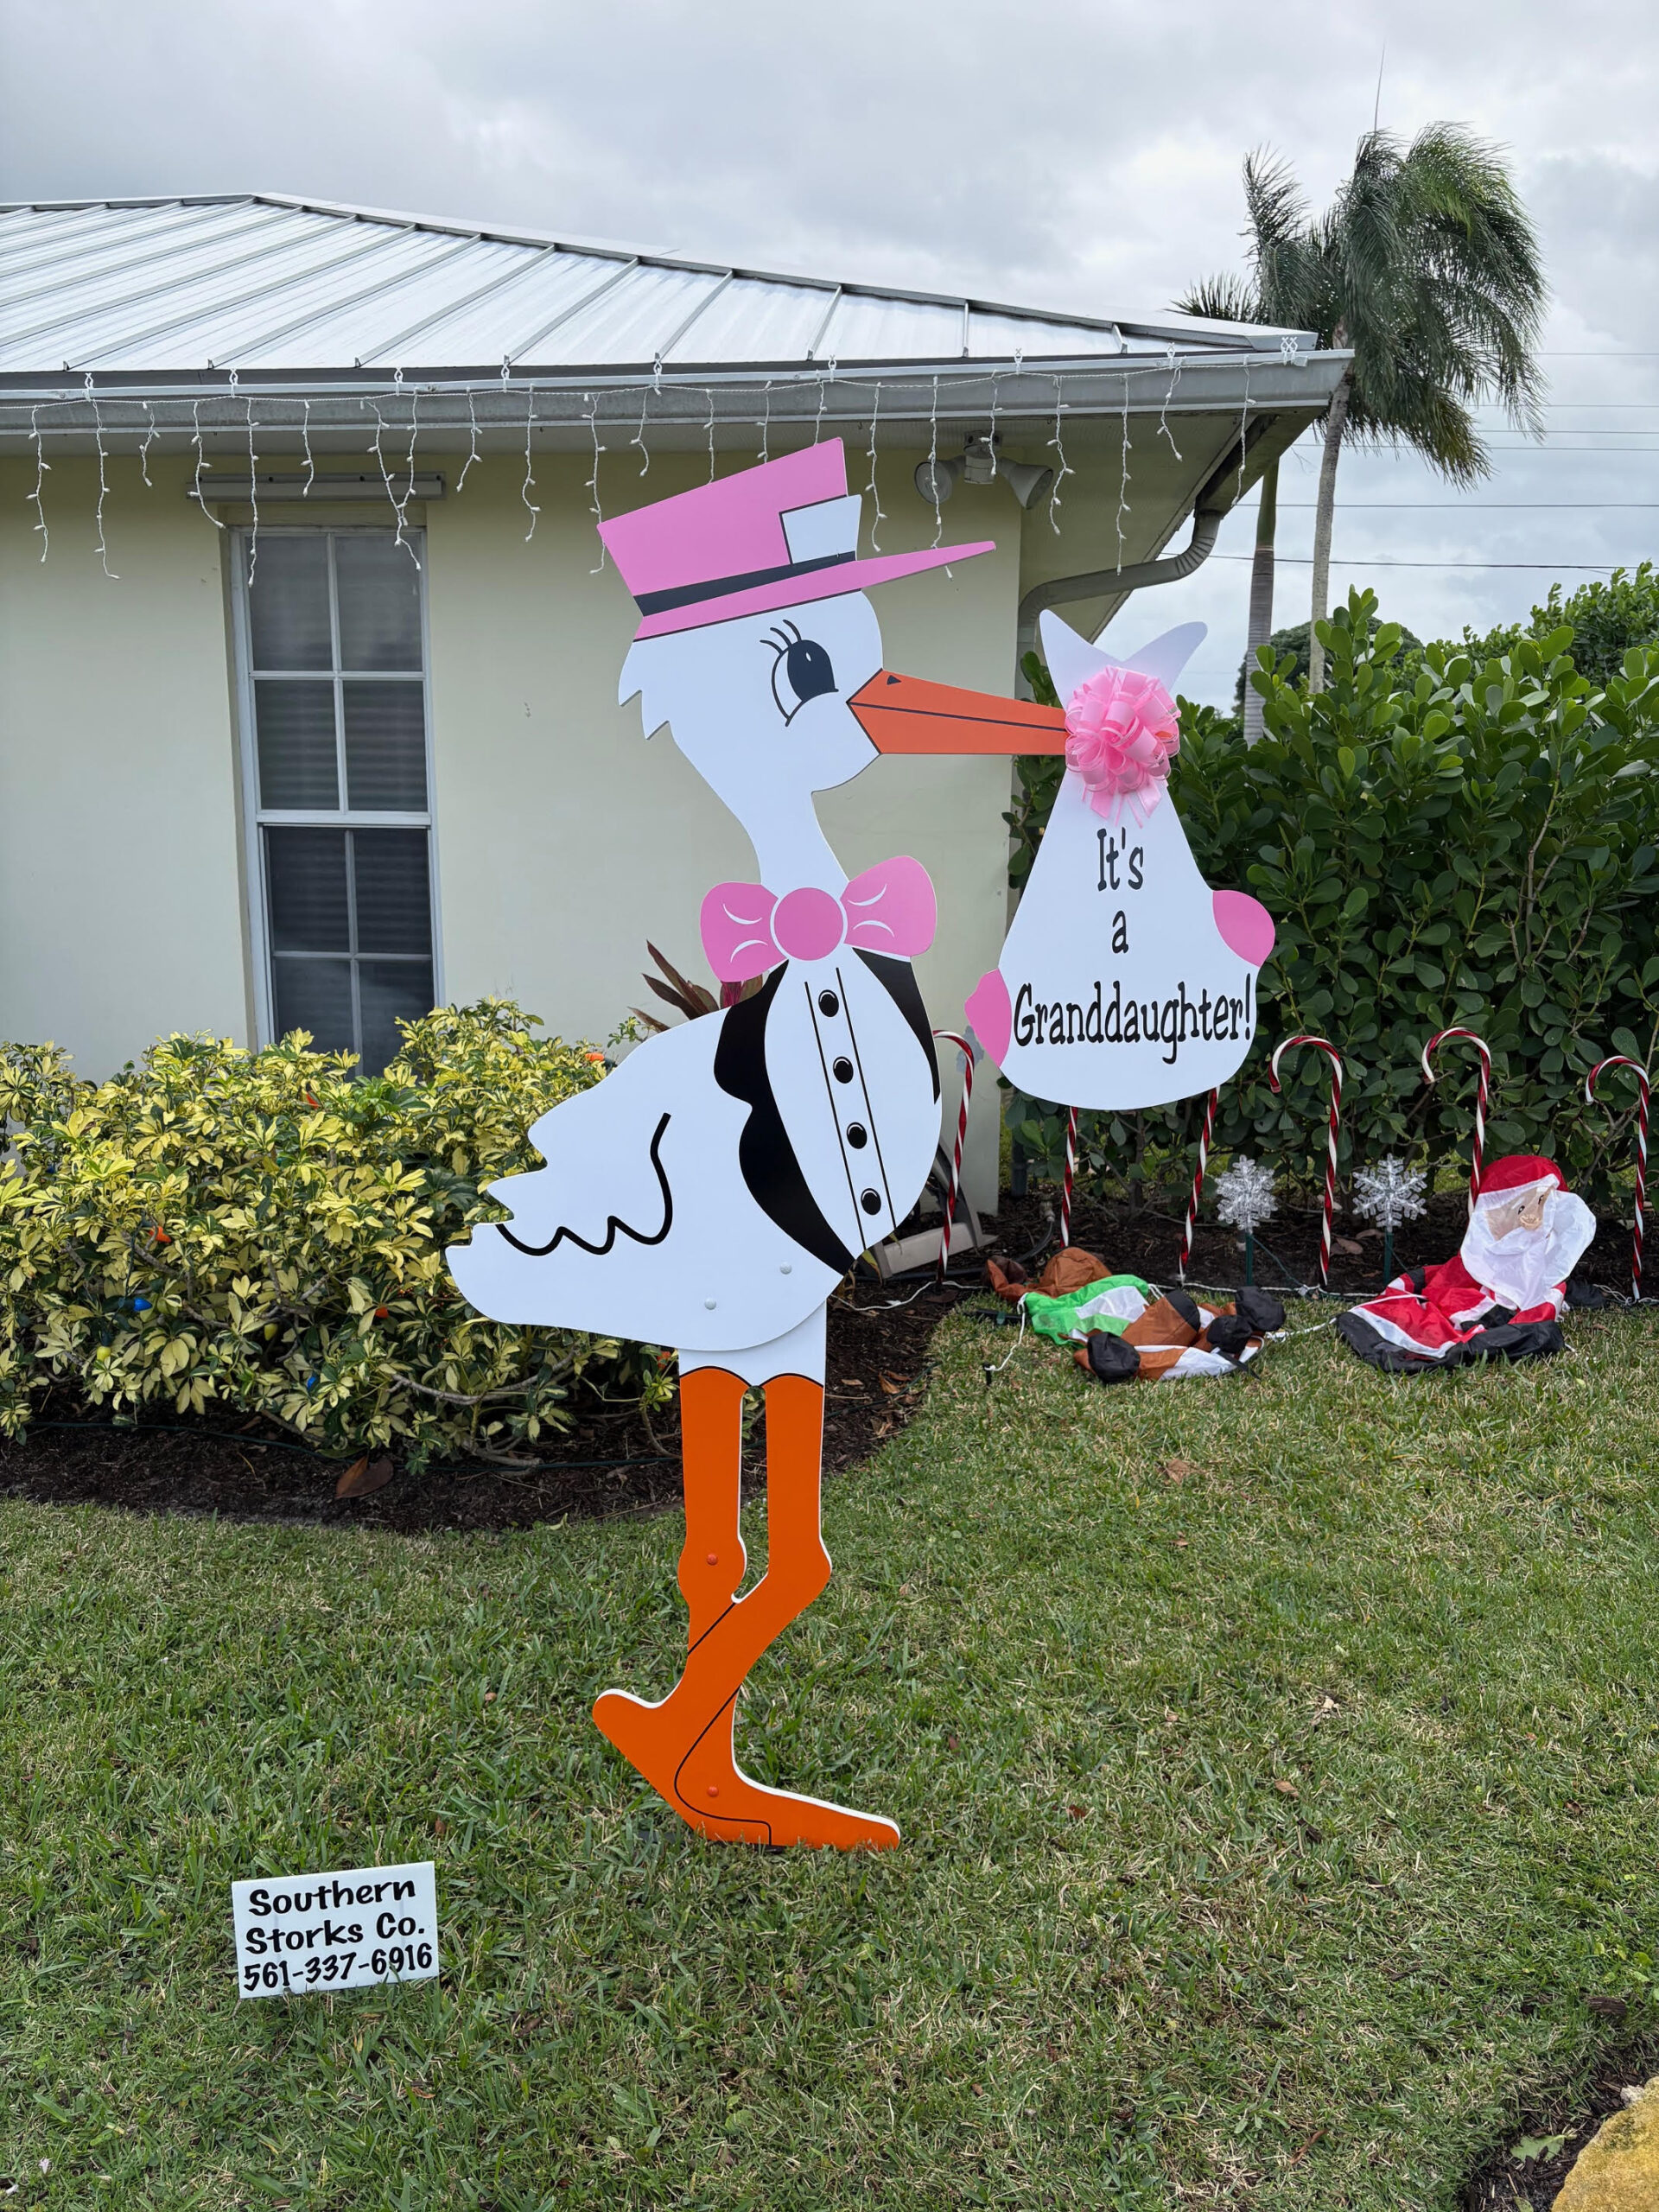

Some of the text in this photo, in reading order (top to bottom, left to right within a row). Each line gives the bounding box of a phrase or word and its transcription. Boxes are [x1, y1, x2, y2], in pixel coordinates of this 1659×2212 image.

[1096, 827, 1144, 892] It's
[1111, 910, 1129, 954] a
[1014, 973, 1251, 1065] Granddaughter!
[248, 1880, 416, 1916] Southern
[245, 1912, 425, 1955] Storks Co.
[243, 1942, 432, 1992] 561-337-6916
